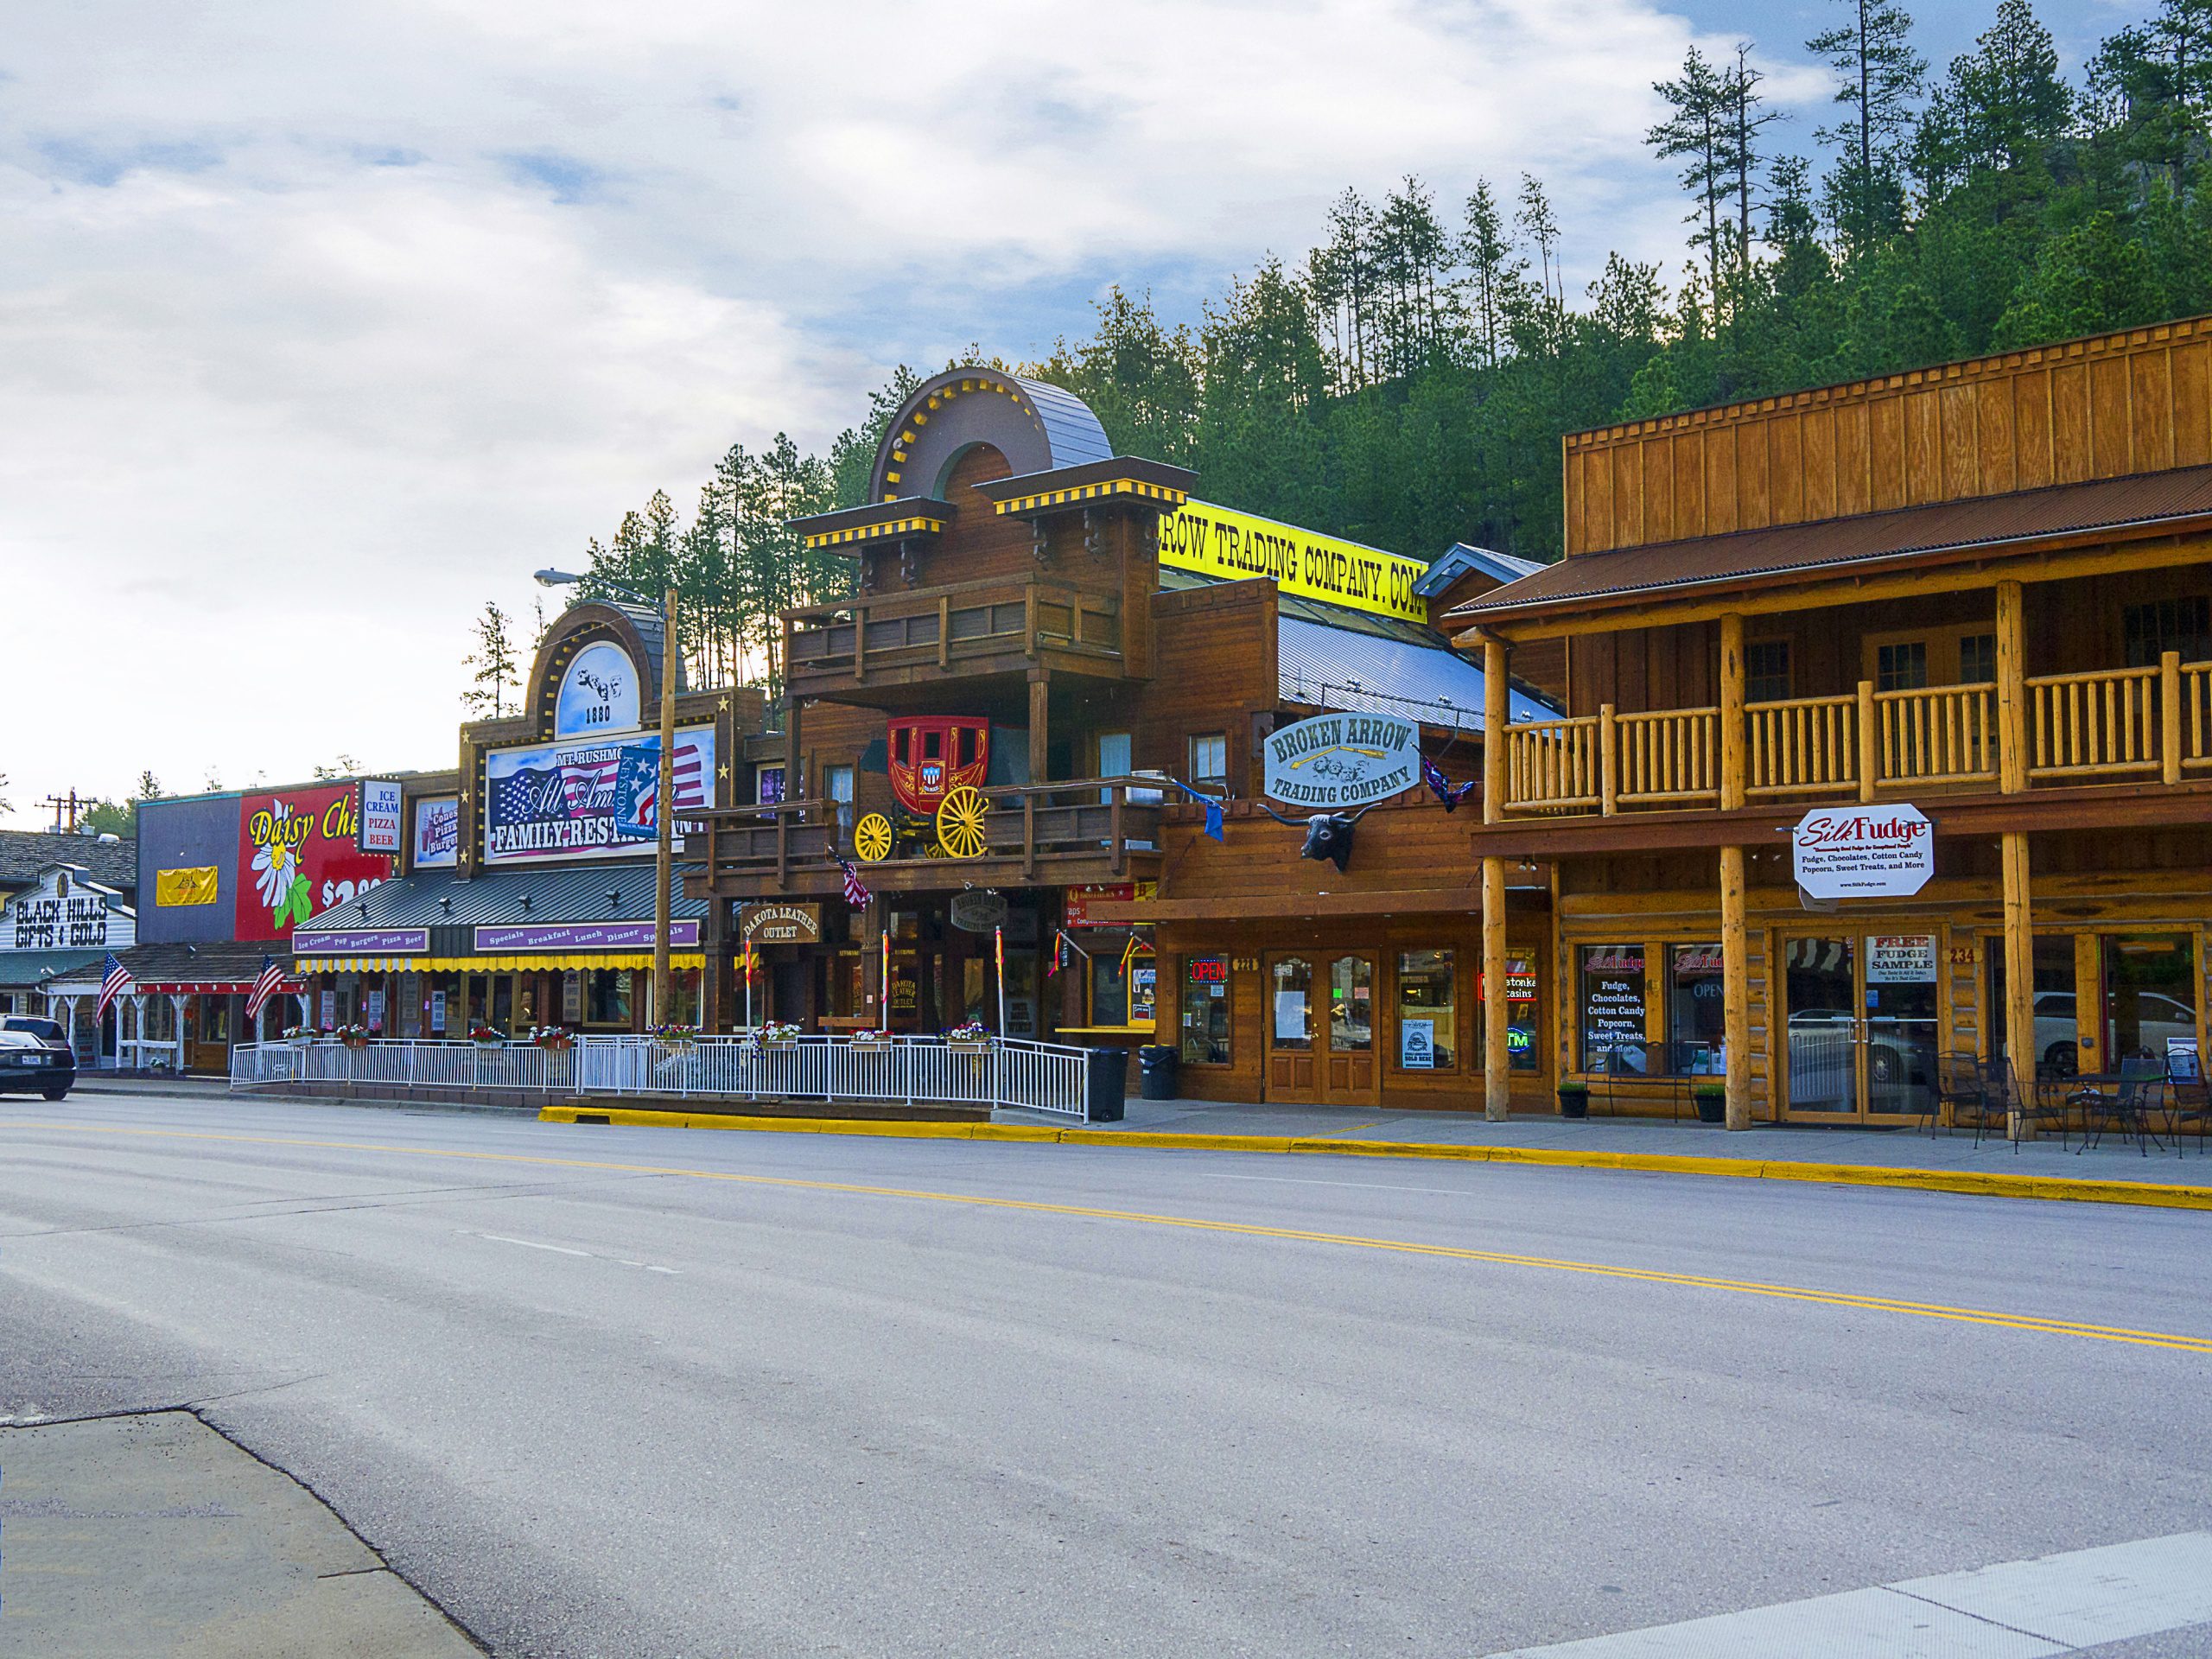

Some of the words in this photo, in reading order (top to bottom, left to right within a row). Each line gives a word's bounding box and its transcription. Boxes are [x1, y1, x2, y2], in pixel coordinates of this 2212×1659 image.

[1158, 512, 1208, 559] ROW
[1215, 522, 1297, 582] TRADING
[587, 705, 610, 724] 1880
[1271, 720, 1342, 763] BROKEN
[1346, 719, 1412, 752] ARROW
[556, 754, 575, 766] MT.
[617, 756, 633, 823] KEYSTONE
[1272, 778, 1337, 803] TRADING
[1340, 766, 1412, 802] COMPANY
[380, 791, 395, 801] ICE
[521, 776, 563, 814] All
[366, 802, 398, 813] CREAM
[433, 809, 458, 825] Cones
[368, 818, 395, 830] PIZZA
[435, 823, 458, 838] Pizza
[249, 803, 315, 865] Daisy
[370, 835, 393, 845] BEER
[494, 819, 562, 851] FAMILY
[1827, 854, 1870, 862] Chocolates,
[1802, 866, 1834, 874] Popcorn,
[16, 899, 60, 924] BLACK
[67, 897, 107, 922] HILLS
[743, 908, 779, 937] DAKOTA
[779, 907, 817, 935] LEATHER
[16, 925, 54, 948] GIFTS
[70, 922, 106, 946] GOLD
[489, 931, 524, 944] Specials
[528, 929, 571, 945] Breakfast
[575, 930, 602, 943] Lunch
[607, 929, 639, 942] Dinner
[643, 926, 683, 942] Spals
[764, 925, 798, 938] OUTLET
[309, 935, 331, 946] Cream
[334, 938, 347, 946] Pop
[351, 935, 378, 948] Burgers
[381, 935, 402, 946] Pizza
[404, 935, 423, 945] Beer
[1874, 937, 1929, 948] FREE
[1949, 948, 1974, 964] 234
[1872, 960, 1933, 969] SAMPLE
[1192, 962, 1226, 981] OPEN
[1601, 982, 1630, 992] Fudge,
[1592, 994, 1641, 1003] Chocolates,
[1587, 1006, 1617, 1015] Cotton
[1618, 1006, 1645, 1017] Candy
[1598, 1019, 1636, 1029] Popcorn,
[1508, 1033, 1528, 1046] TM
[1587, 1031, 1613, 1040] Sweet
[1615, 1031, 1646, 1041] Treats,
[1597, 1044, 1612, 1052] and
